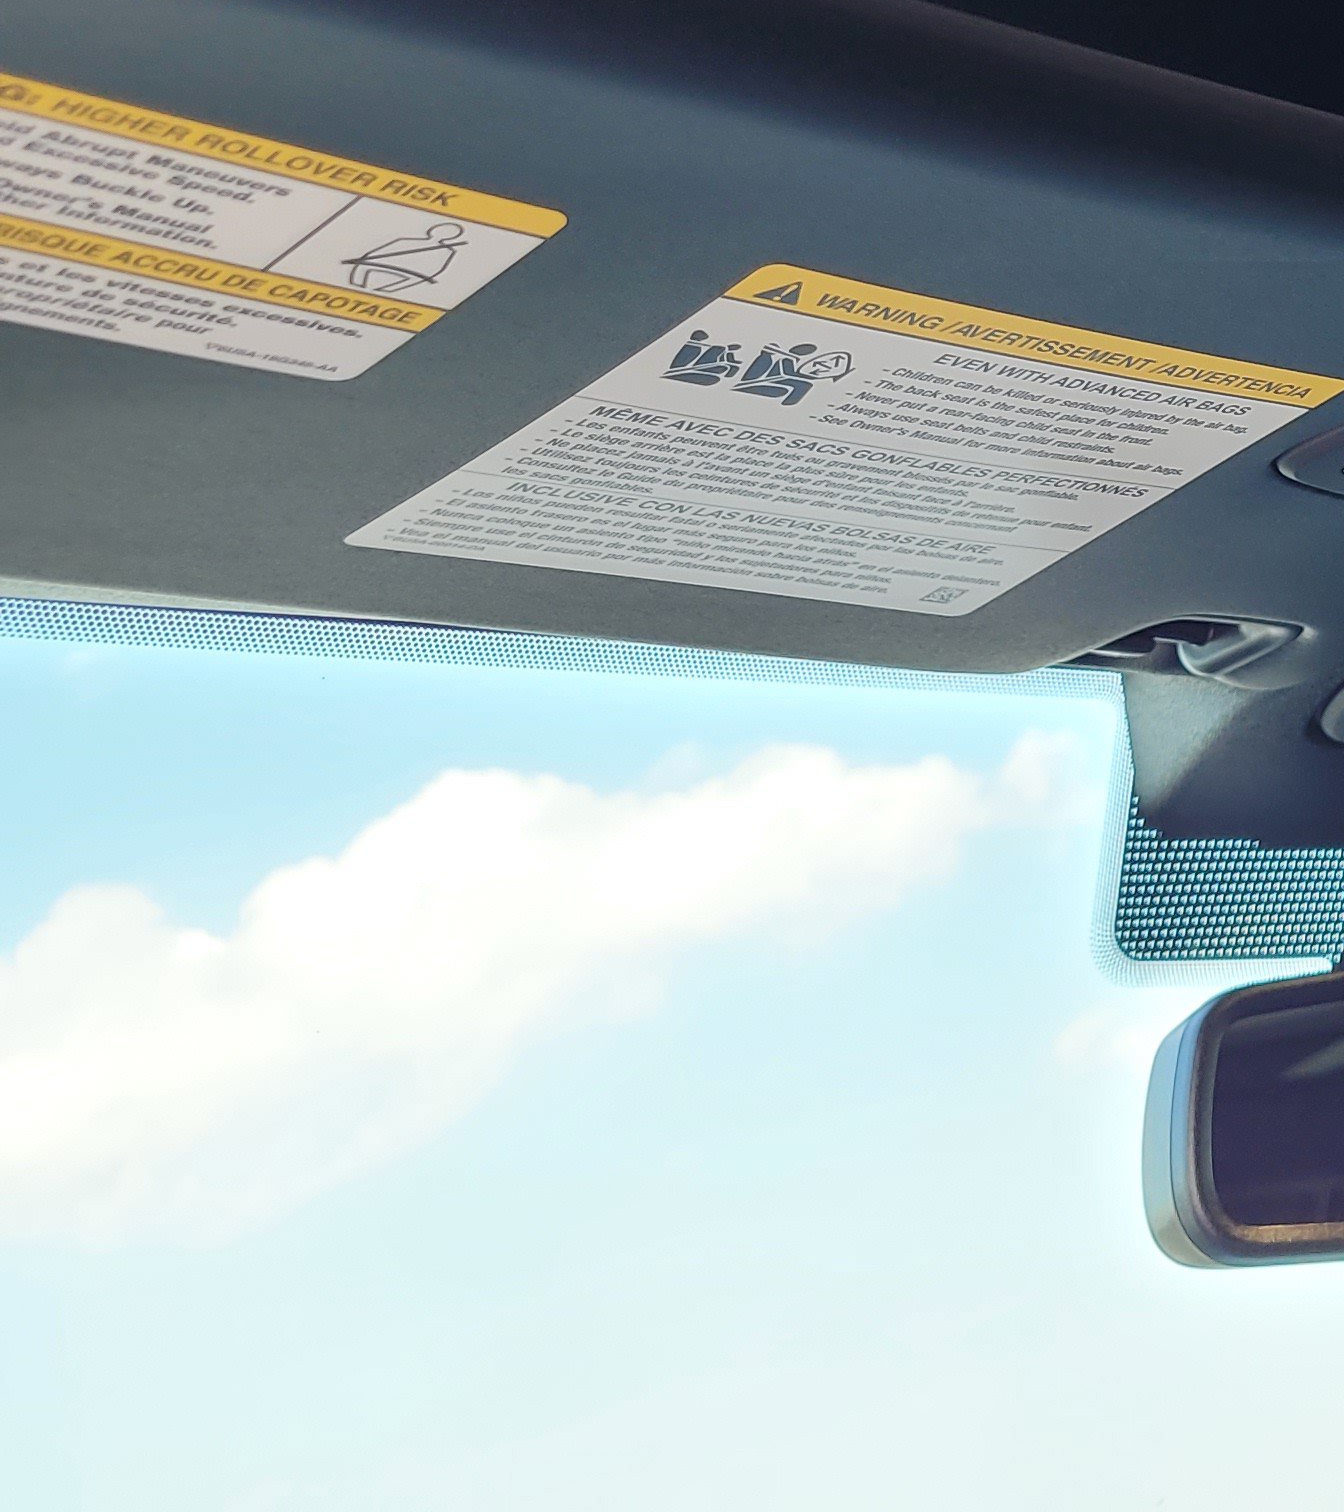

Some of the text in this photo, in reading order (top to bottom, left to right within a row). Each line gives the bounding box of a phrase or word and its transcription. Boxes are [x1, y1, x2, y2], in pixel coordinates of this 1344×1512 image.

[50, 98, 193, 143] HIGHER
[194, 133, 379, 188] ROLLOVER
[378, 179, 459, 207] RISK
[108, 250, 222, 282] ACCRU
[219, 273, 267, 292] DE
[267, 284, 423, 324] CAPOTAGE
[816, 293, 1313, 399] WARNING /AVERTISSEMENT /ADVERTENCIA
[853, 391, 902, 406] Never
[895, 400, 929, 411] put
[937, 408, 1017, 427] rear-facing
[1014, 420, 1054, 432] child
[1049, 426, 1084, 437] seat
[1079, 429, 1097, 439] in
[1095, 431, 1120, 441] the
[1118, 434, 1154, 446] front.
[874, 379, 1170, 436] The back seat is the safest place for children.
[891, 367, 1249, 435] Children can be killed or seriously injured by the air bag.
[933, 353, 1252, 416] EVEN WITH ADVANCED AIR BAGS
[588, 405, 1149, 498] MÊME AVEC DES SACS GONFLABLES PERFECTIONNÉS
[817, 414, 1184, 476] See Owner's Manual for more information about air bags.
[834, 403, 1116, 454] Always use seat belts and child restraints.
[505, 481, 997, 555] INCLUSIVE CON LAS NUEVAS BOLSAS DE AIRE
